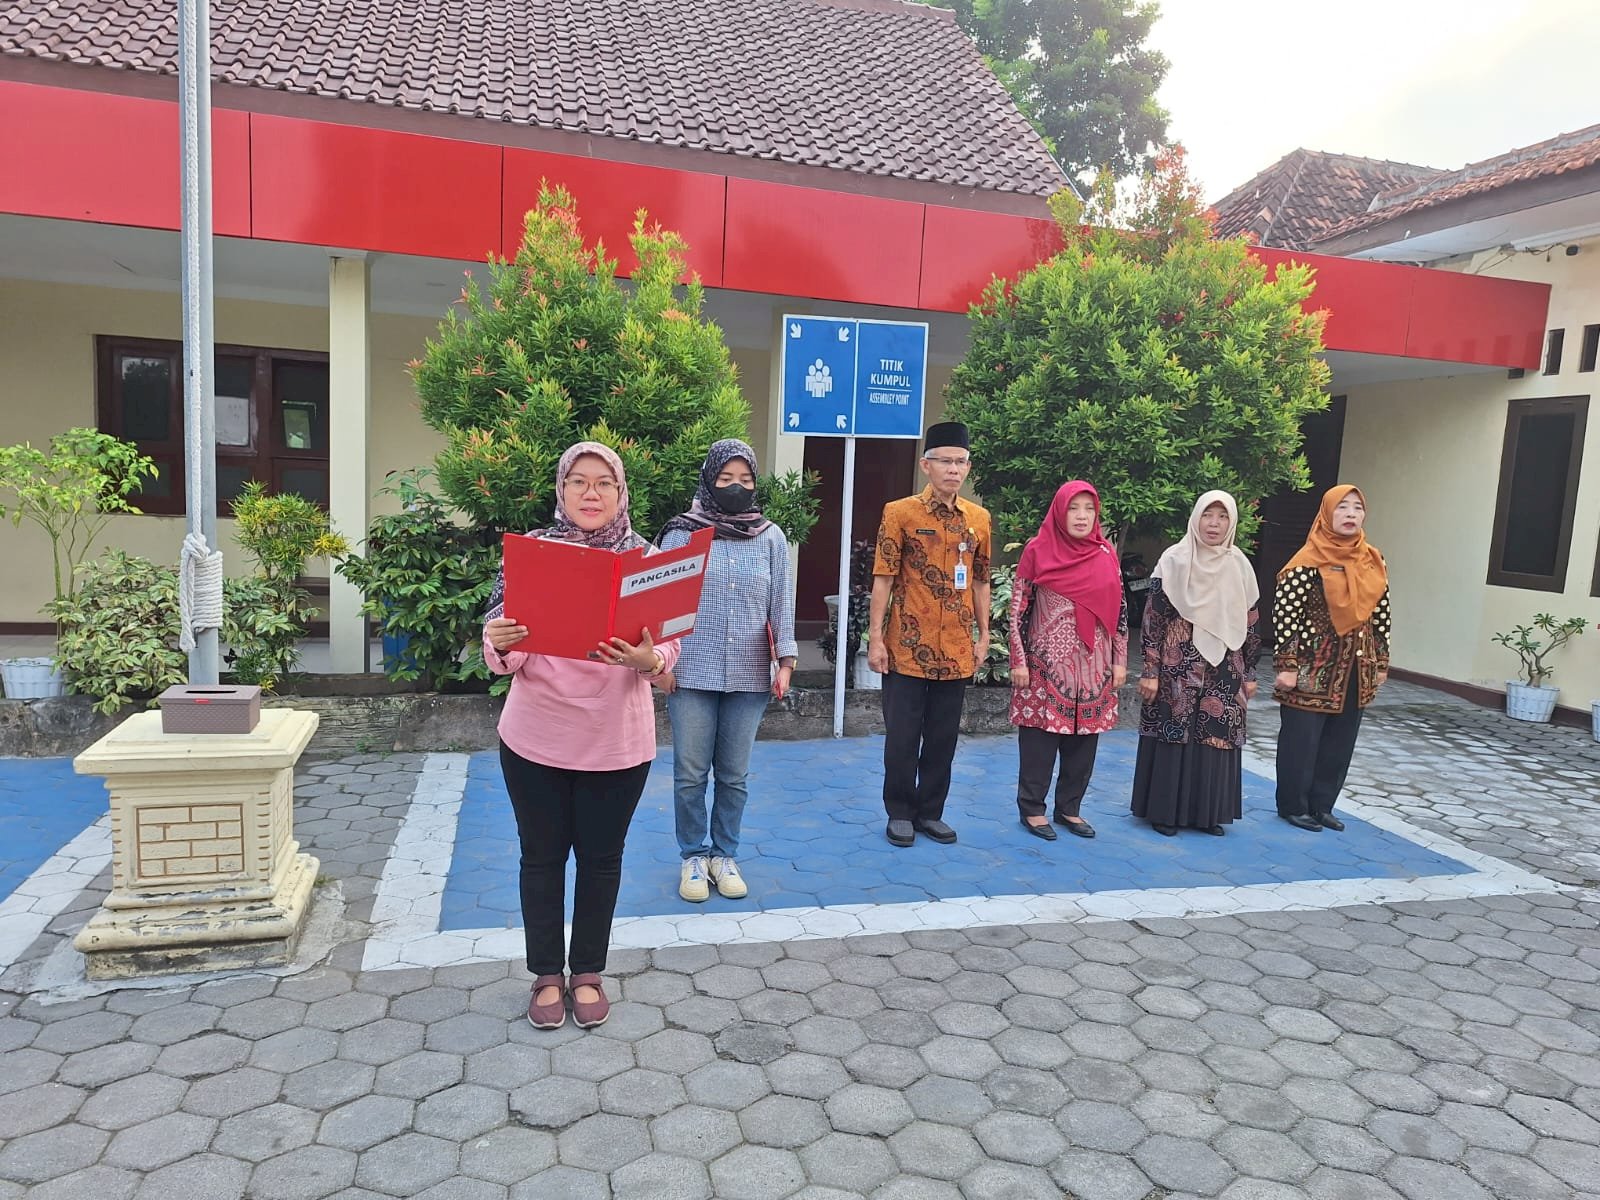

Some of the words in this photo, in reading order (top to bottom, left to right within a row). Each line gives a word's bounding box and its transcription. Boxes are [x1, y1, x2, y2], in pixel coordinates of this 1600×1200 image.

[880, 359, 904, 372] TITIK
[870, 373, 911, 387] KUMPUL
[895, 394, 910, 406] POINT
[631, 563, 696, 588] PANCASILA
